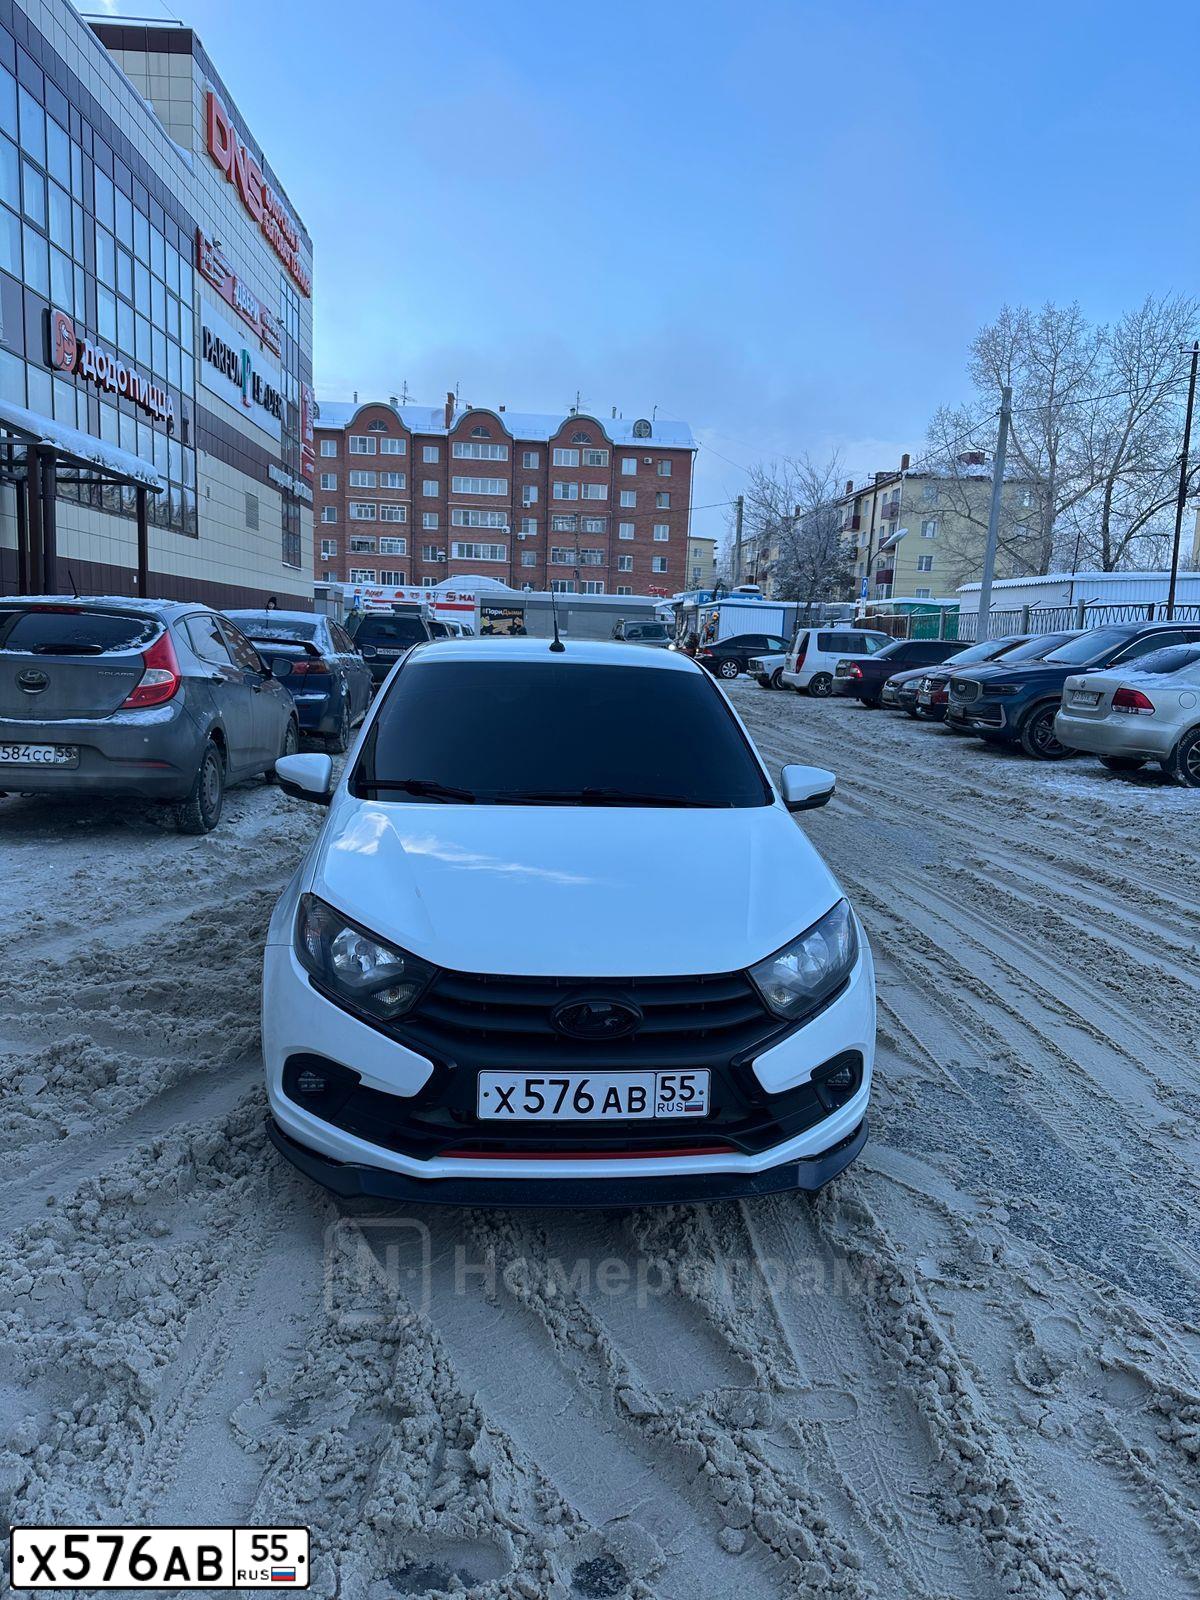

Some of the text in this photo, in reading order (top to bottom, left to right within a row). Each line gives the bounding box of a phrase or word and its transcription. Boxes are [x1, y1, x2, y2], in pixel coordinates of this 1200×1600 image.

[207, 91, 263, 222] DNS
[203, 326, 242, 388] PARFUM
[493, 1075, 696, 1114] Х576АВ 55
[657, 1102, 683, 1113] RUS
